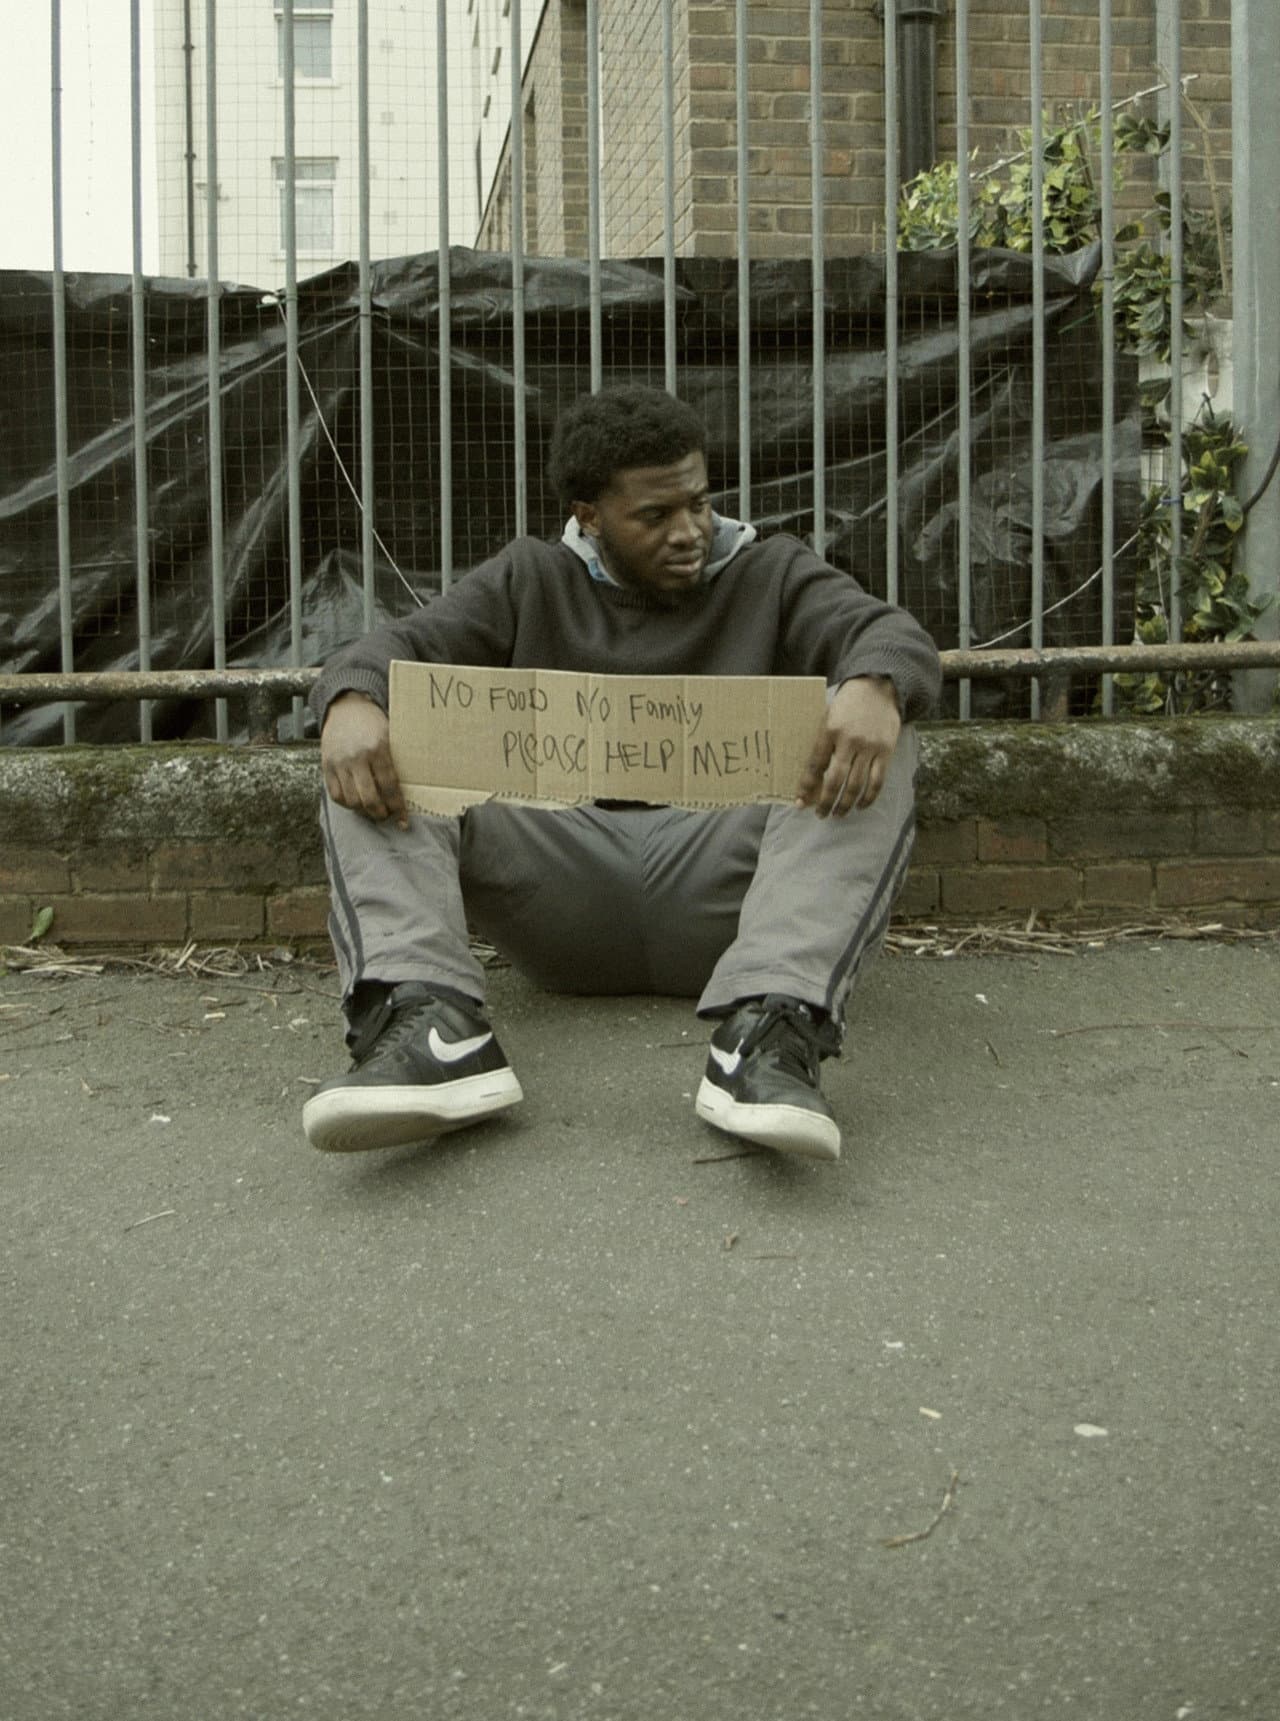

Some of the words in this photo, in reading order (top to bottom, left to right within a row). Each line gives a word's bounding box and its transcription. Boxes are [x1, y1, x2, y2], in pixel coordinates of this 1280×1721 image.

[429, 673, 473, 708] NO
[489, 687, 548, 712] FOOD
[629, 693, 703, 737] Family
[605, 740, 675, 774] HELP
[693, 731, 771, 777] ME!!!
